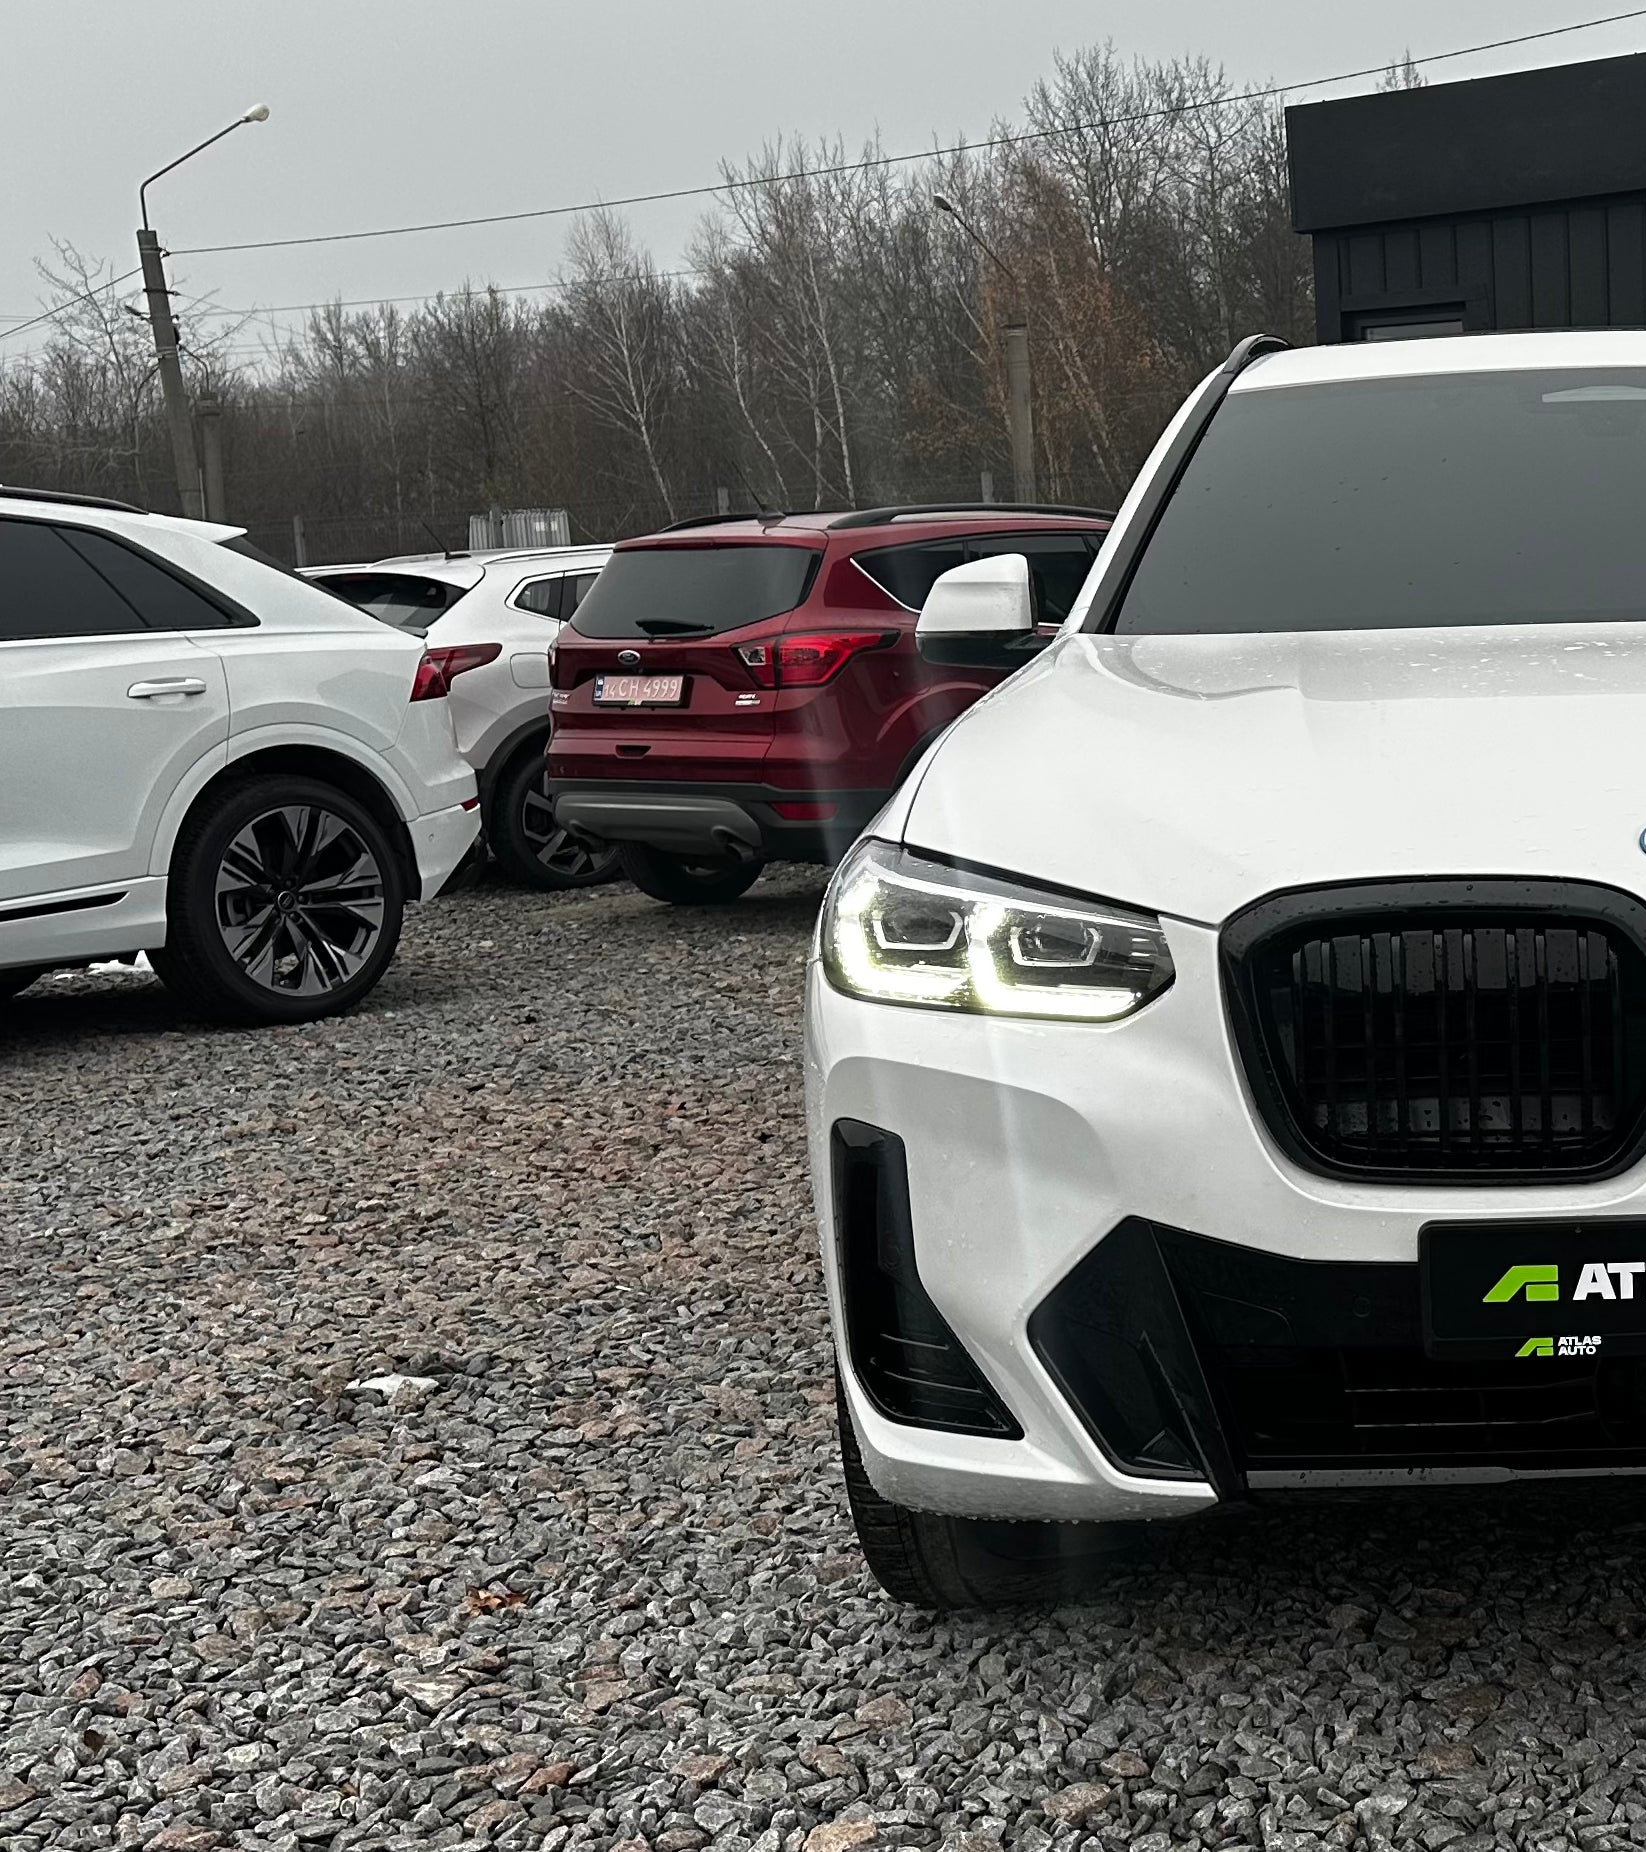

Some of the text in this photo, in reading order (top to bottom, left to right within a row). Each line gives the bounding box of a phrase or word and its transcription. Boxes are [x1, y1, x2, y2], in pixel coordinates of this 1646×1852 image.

[643, 679, 678, 698] 4999
[1557, 1335, 1602, 1346] ATLAS
[1557, 1346, 1597, 1357] AUTO
